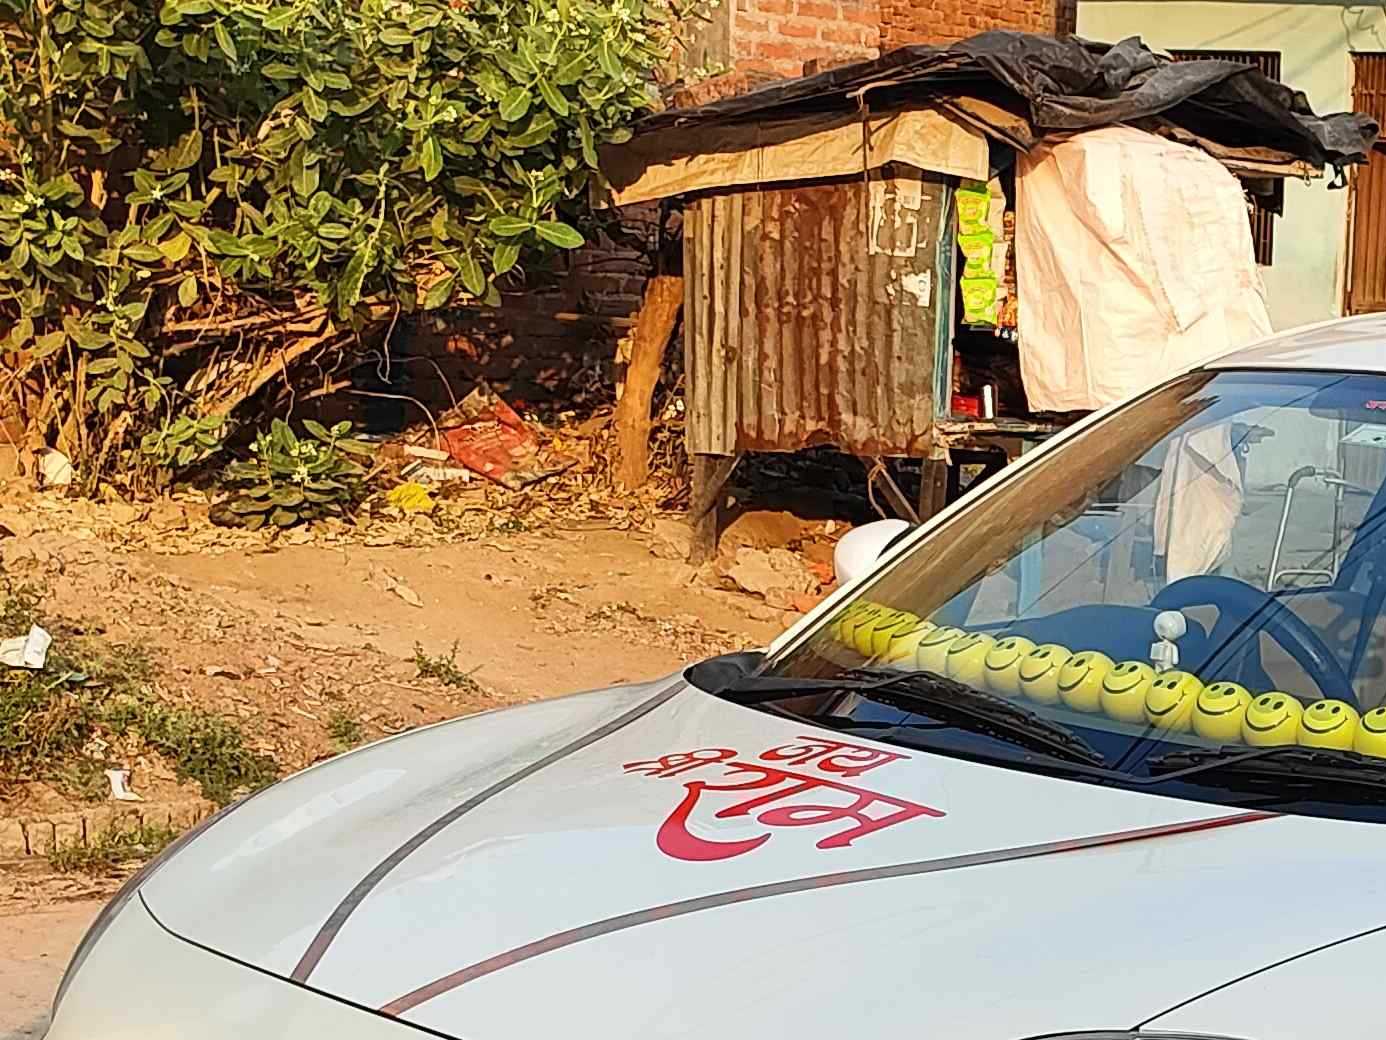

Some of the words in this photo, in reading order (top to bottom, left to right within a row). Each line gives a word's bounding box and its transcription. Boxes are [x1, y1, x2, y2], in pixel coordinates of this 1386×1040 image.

[623, 748, 738, 778] श्री
[759, 735, 912, 777] जय
[656, 762, 946, 861] राम
